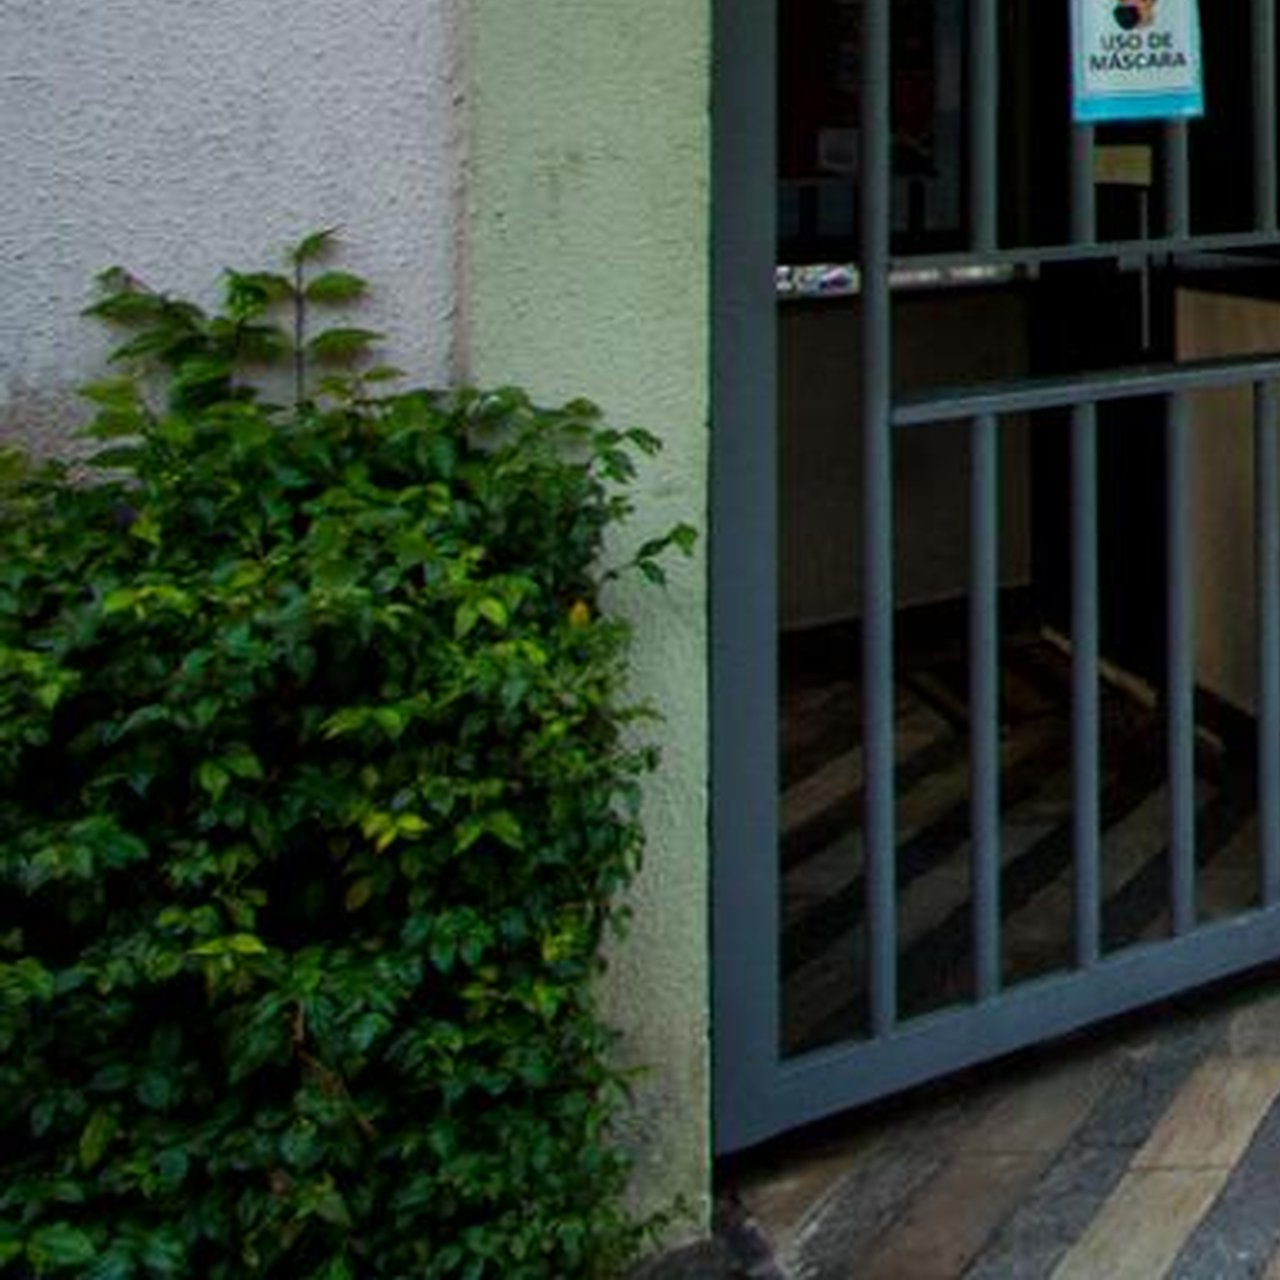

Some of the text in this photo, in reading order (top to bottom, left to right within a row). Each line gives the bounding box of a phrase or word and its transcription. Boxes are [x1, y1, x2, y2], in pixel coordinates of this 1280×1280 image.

[1101, 32, 1174, 51] USO DE
[1090, 51, 1187, 71] MÁSCARA
